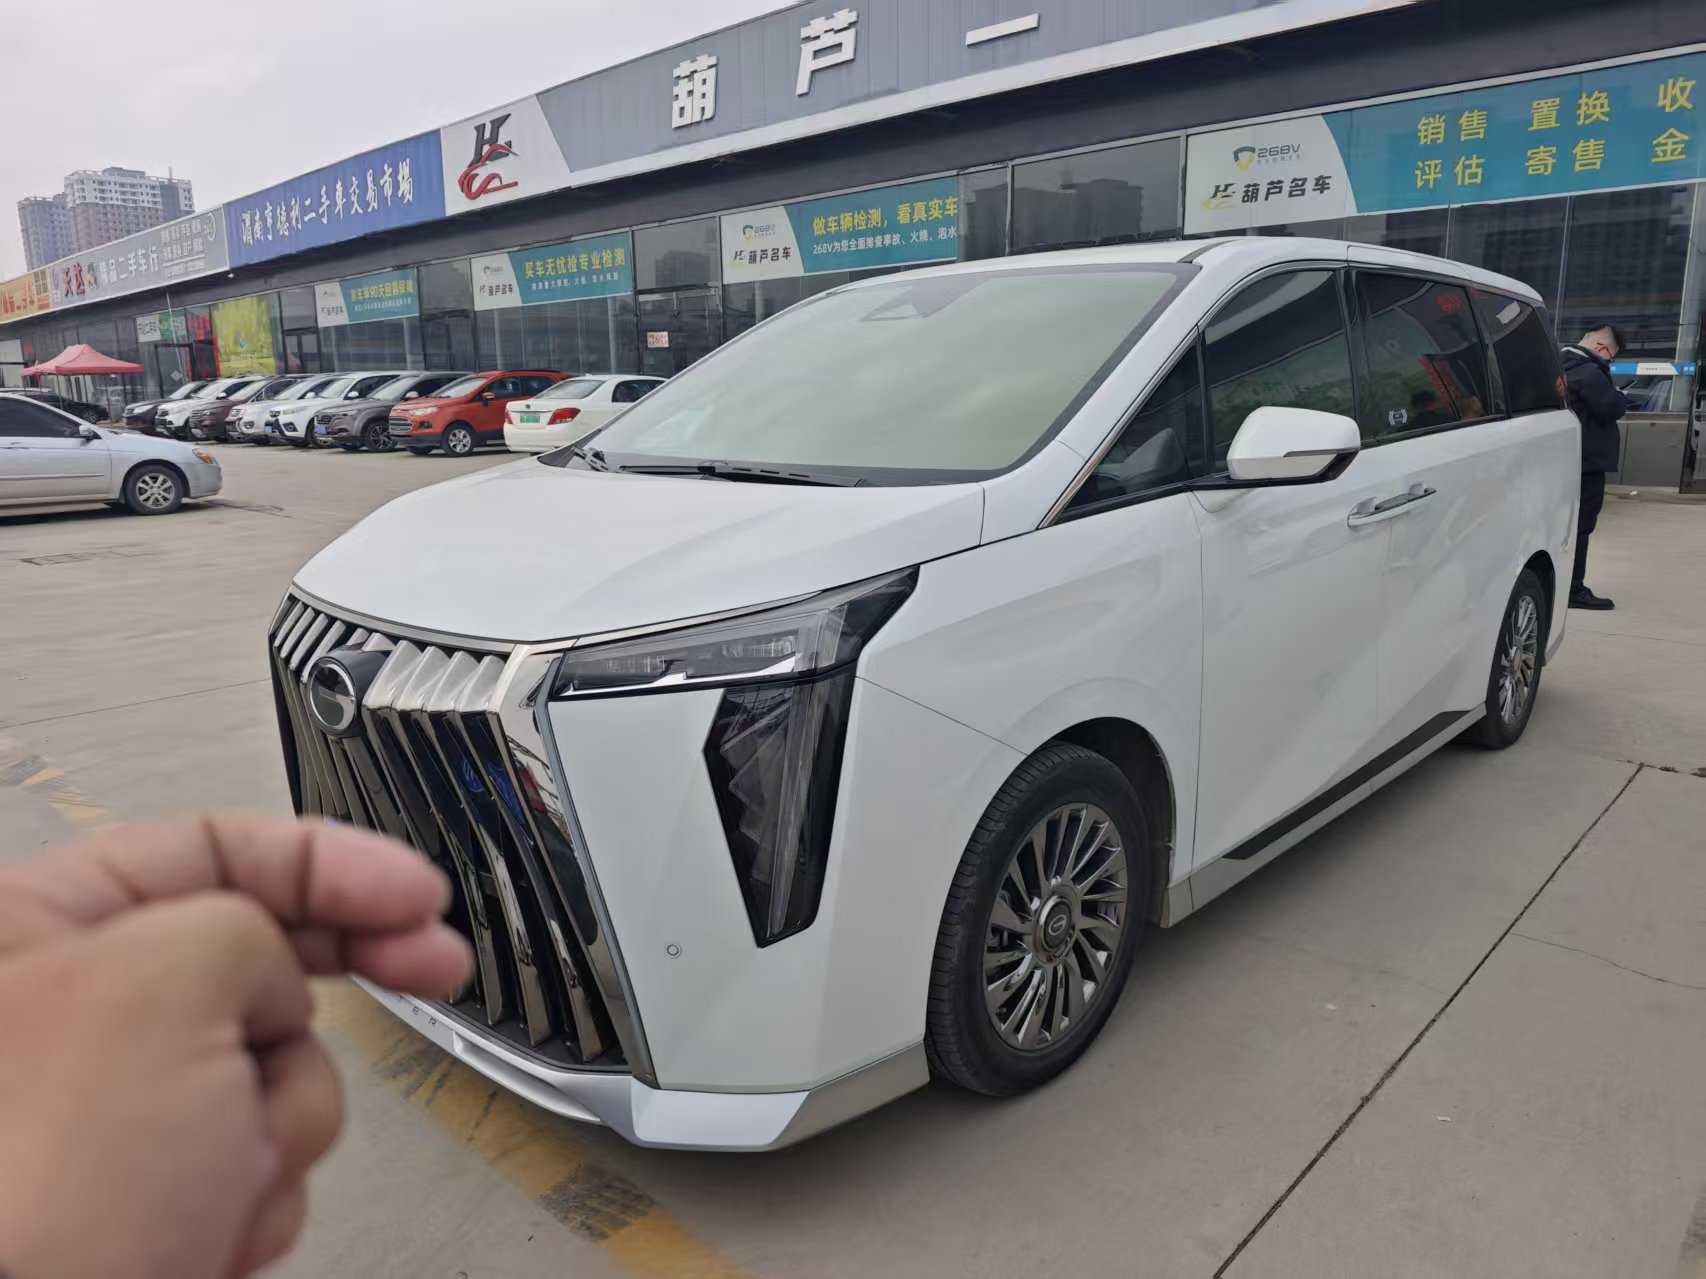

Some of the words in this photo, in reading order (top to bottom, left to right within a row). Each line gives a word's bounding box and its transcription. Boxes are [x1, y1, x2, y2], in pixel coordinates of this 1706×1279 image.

[1417, 110, 1488, 145] 销售
[1528, 90, 1610, 132] 置换
[1657, 77, 1696, 112] 收
[1257, 143, 1301, 159] 268V
[1414, 154, 1485, 190] 评估
[1525, 138, 1606, 177] 寄售
[1651, 127, 1689, 163] 金
[1241, 174, 1332, 203] 葫芦名车
